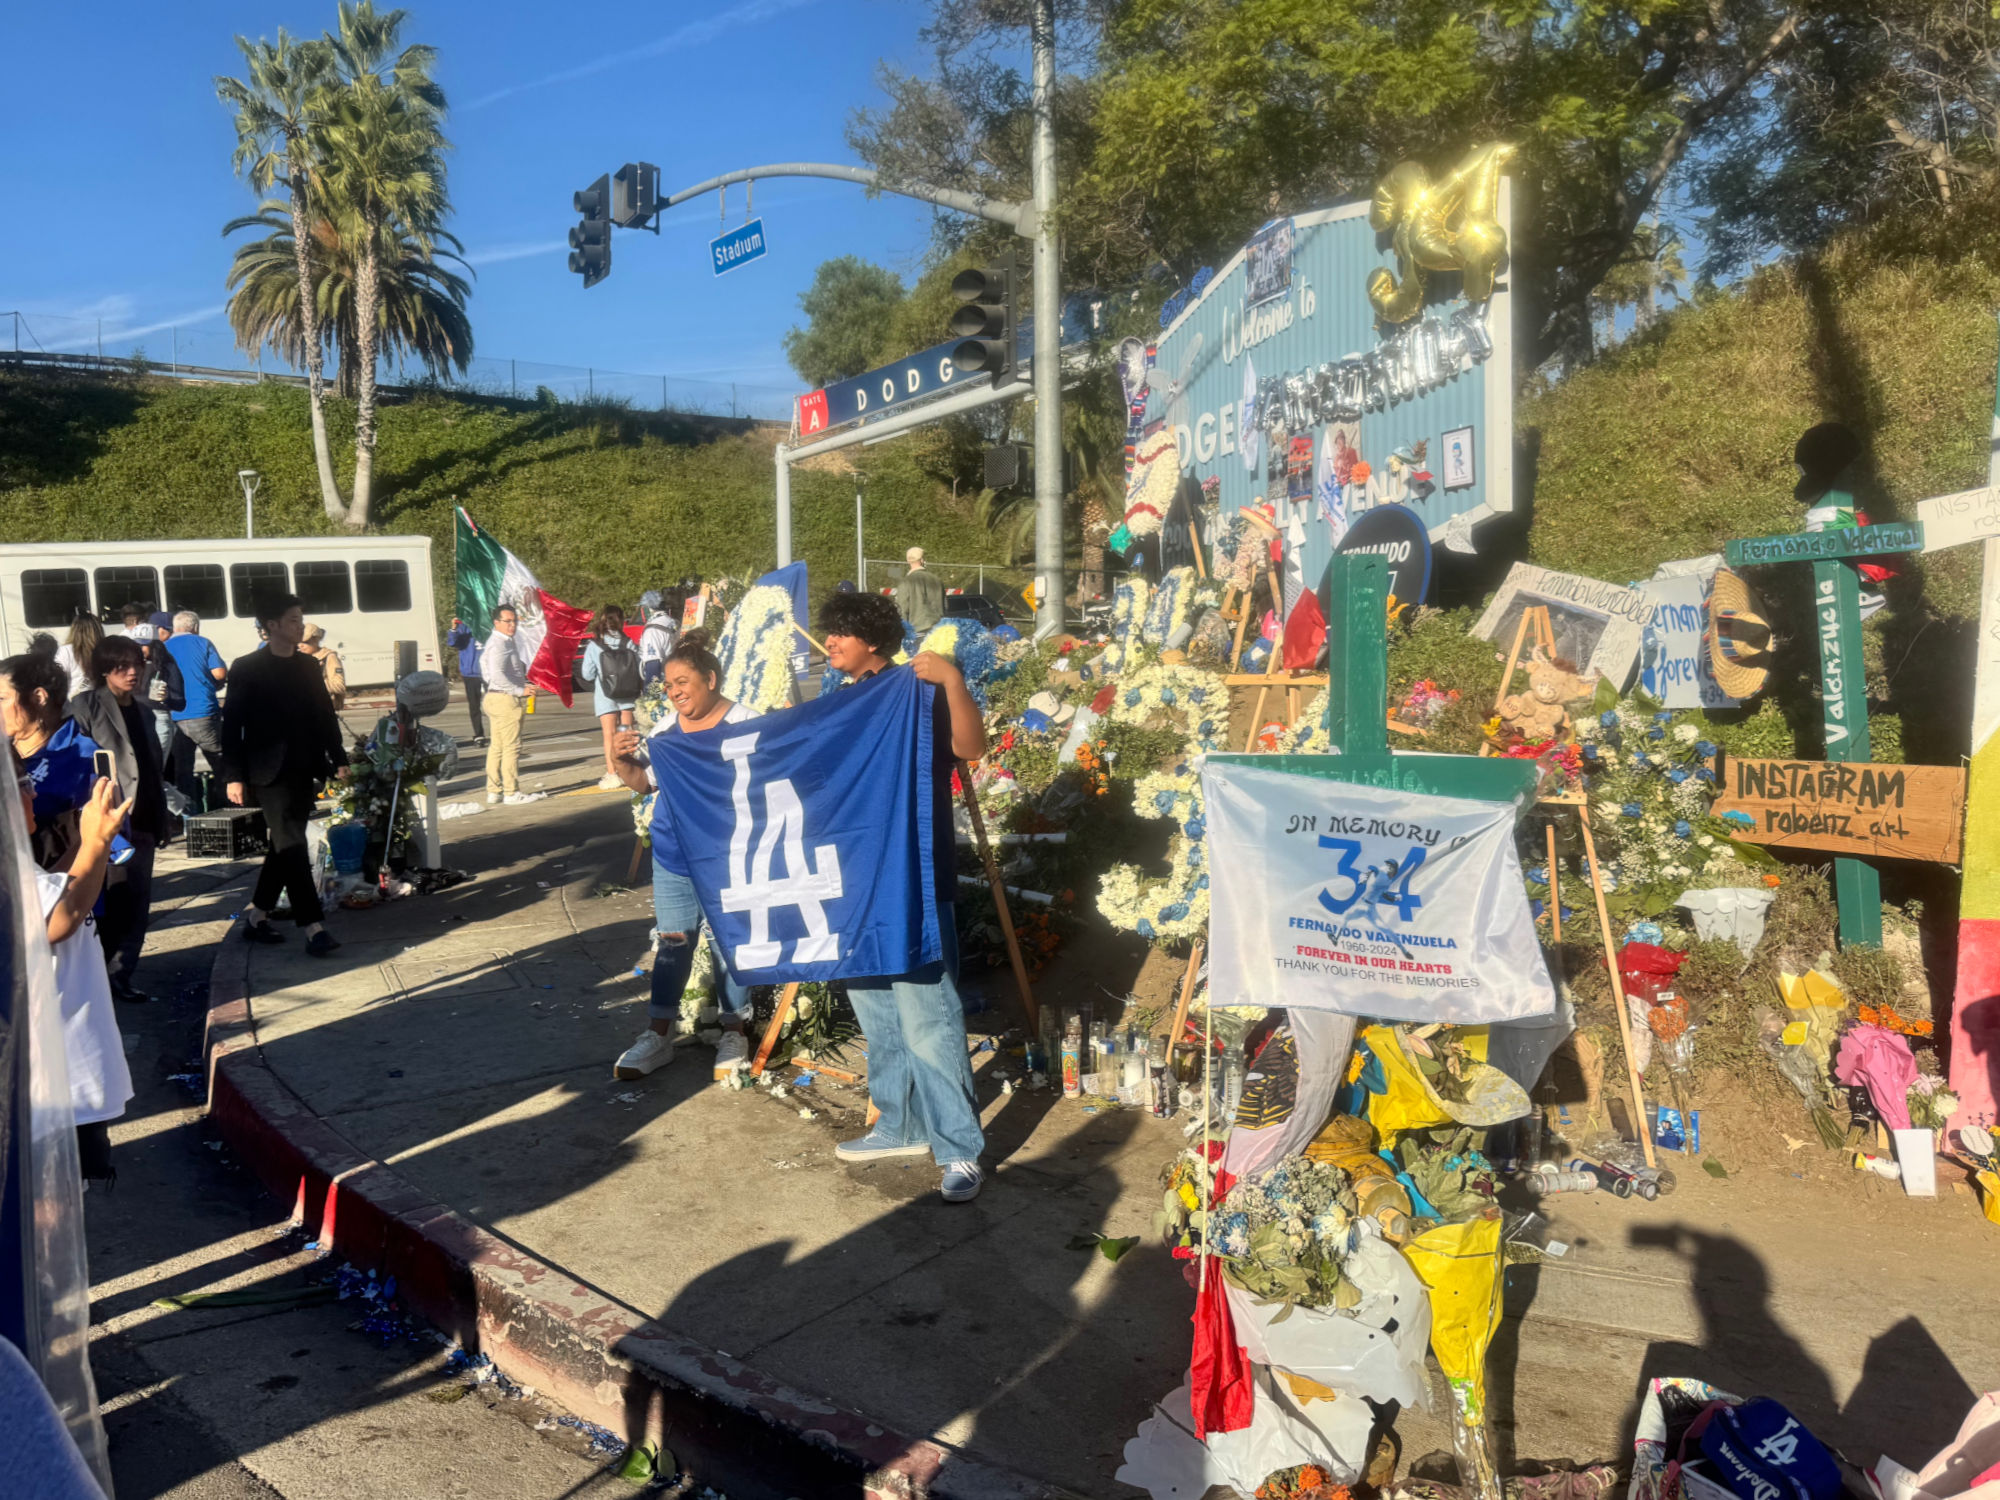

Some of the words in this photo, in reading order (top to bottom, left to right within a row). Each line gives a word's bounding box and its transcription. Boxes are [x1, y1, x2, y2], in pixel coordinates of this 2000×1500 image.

[715, 233, 762, 266] Stadium
[1222, 296, 1294, 364] Welcome
[1297, 275, 1316, 319] to
[803, 394, 822, 408] GATE
[856, 357, 954, 412] DODG
[809, 409, 820, 431] A
[1175, 400, 1246, 470] DGE
[1342, 540, 1412, 563] ANDO
[1737, 762, 1905, 809] INSTAGRAM
[1285, 814, 1317, 834] IN
[1328, 815, 1441, 847] MEMORY
[721, 732, 844, 971] LA
[1317, 834, 1427, 922] 34
[1297, 945, 1351, 963] FOREVER
[1355, 954, 1369, 966] IN
[1371, 956, 1396, 969] OUR
[1399, 960, 1453, 975] HEARTS
[1340, 940, 1398, 956] 1960-2024
[1275, 958, 1320, 973] THANK
[1322, 963, 1348, 977] YOU
[1351, 967, 1377, 981] FOR
[1379, 971, 1402, 985] THE
[1406, 975, 1481, 989] MEMORIES
[1754, 1416, 1800, 1466] LA
